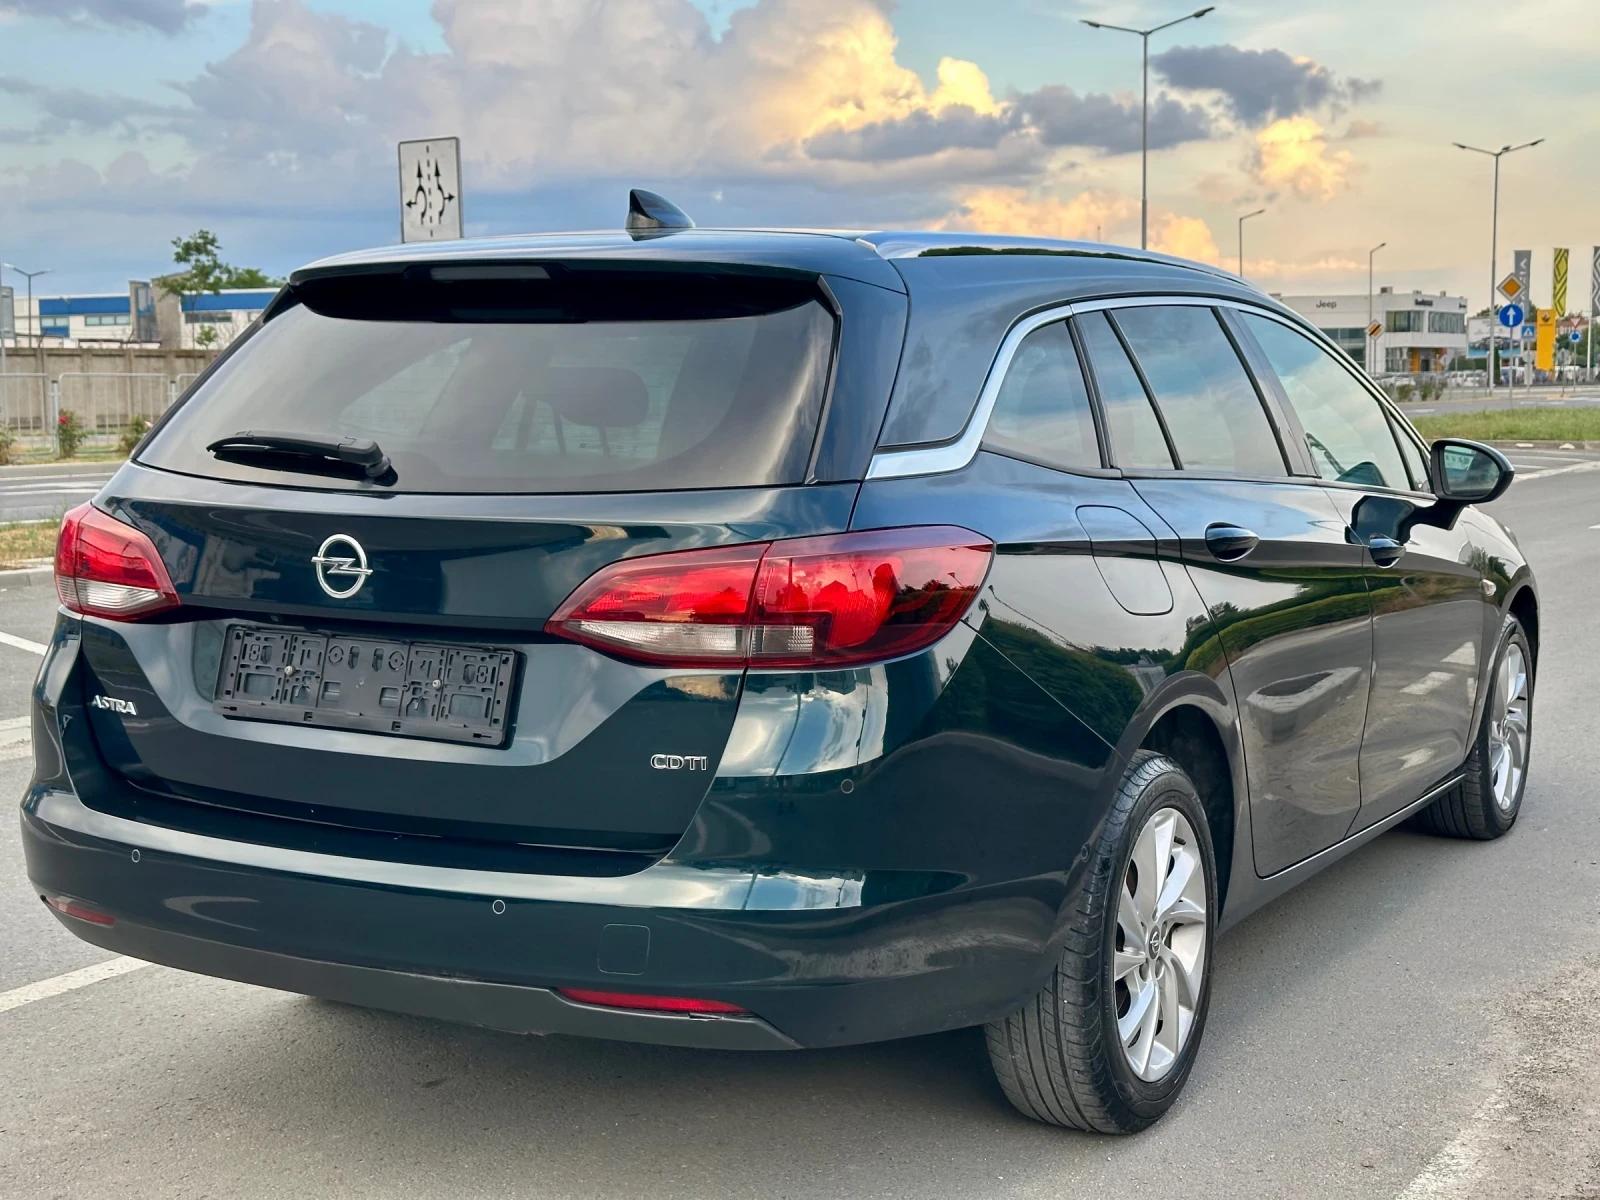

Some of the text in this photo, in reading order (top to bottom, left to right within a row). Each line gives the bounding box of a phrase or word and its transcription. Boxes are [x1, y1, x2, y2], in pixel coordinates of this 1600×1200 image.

[1316, 299, 1337, 310] Jeep
[91, 694, 138, 716] ASTRA
[650, 753, 708, 771] CDTI
